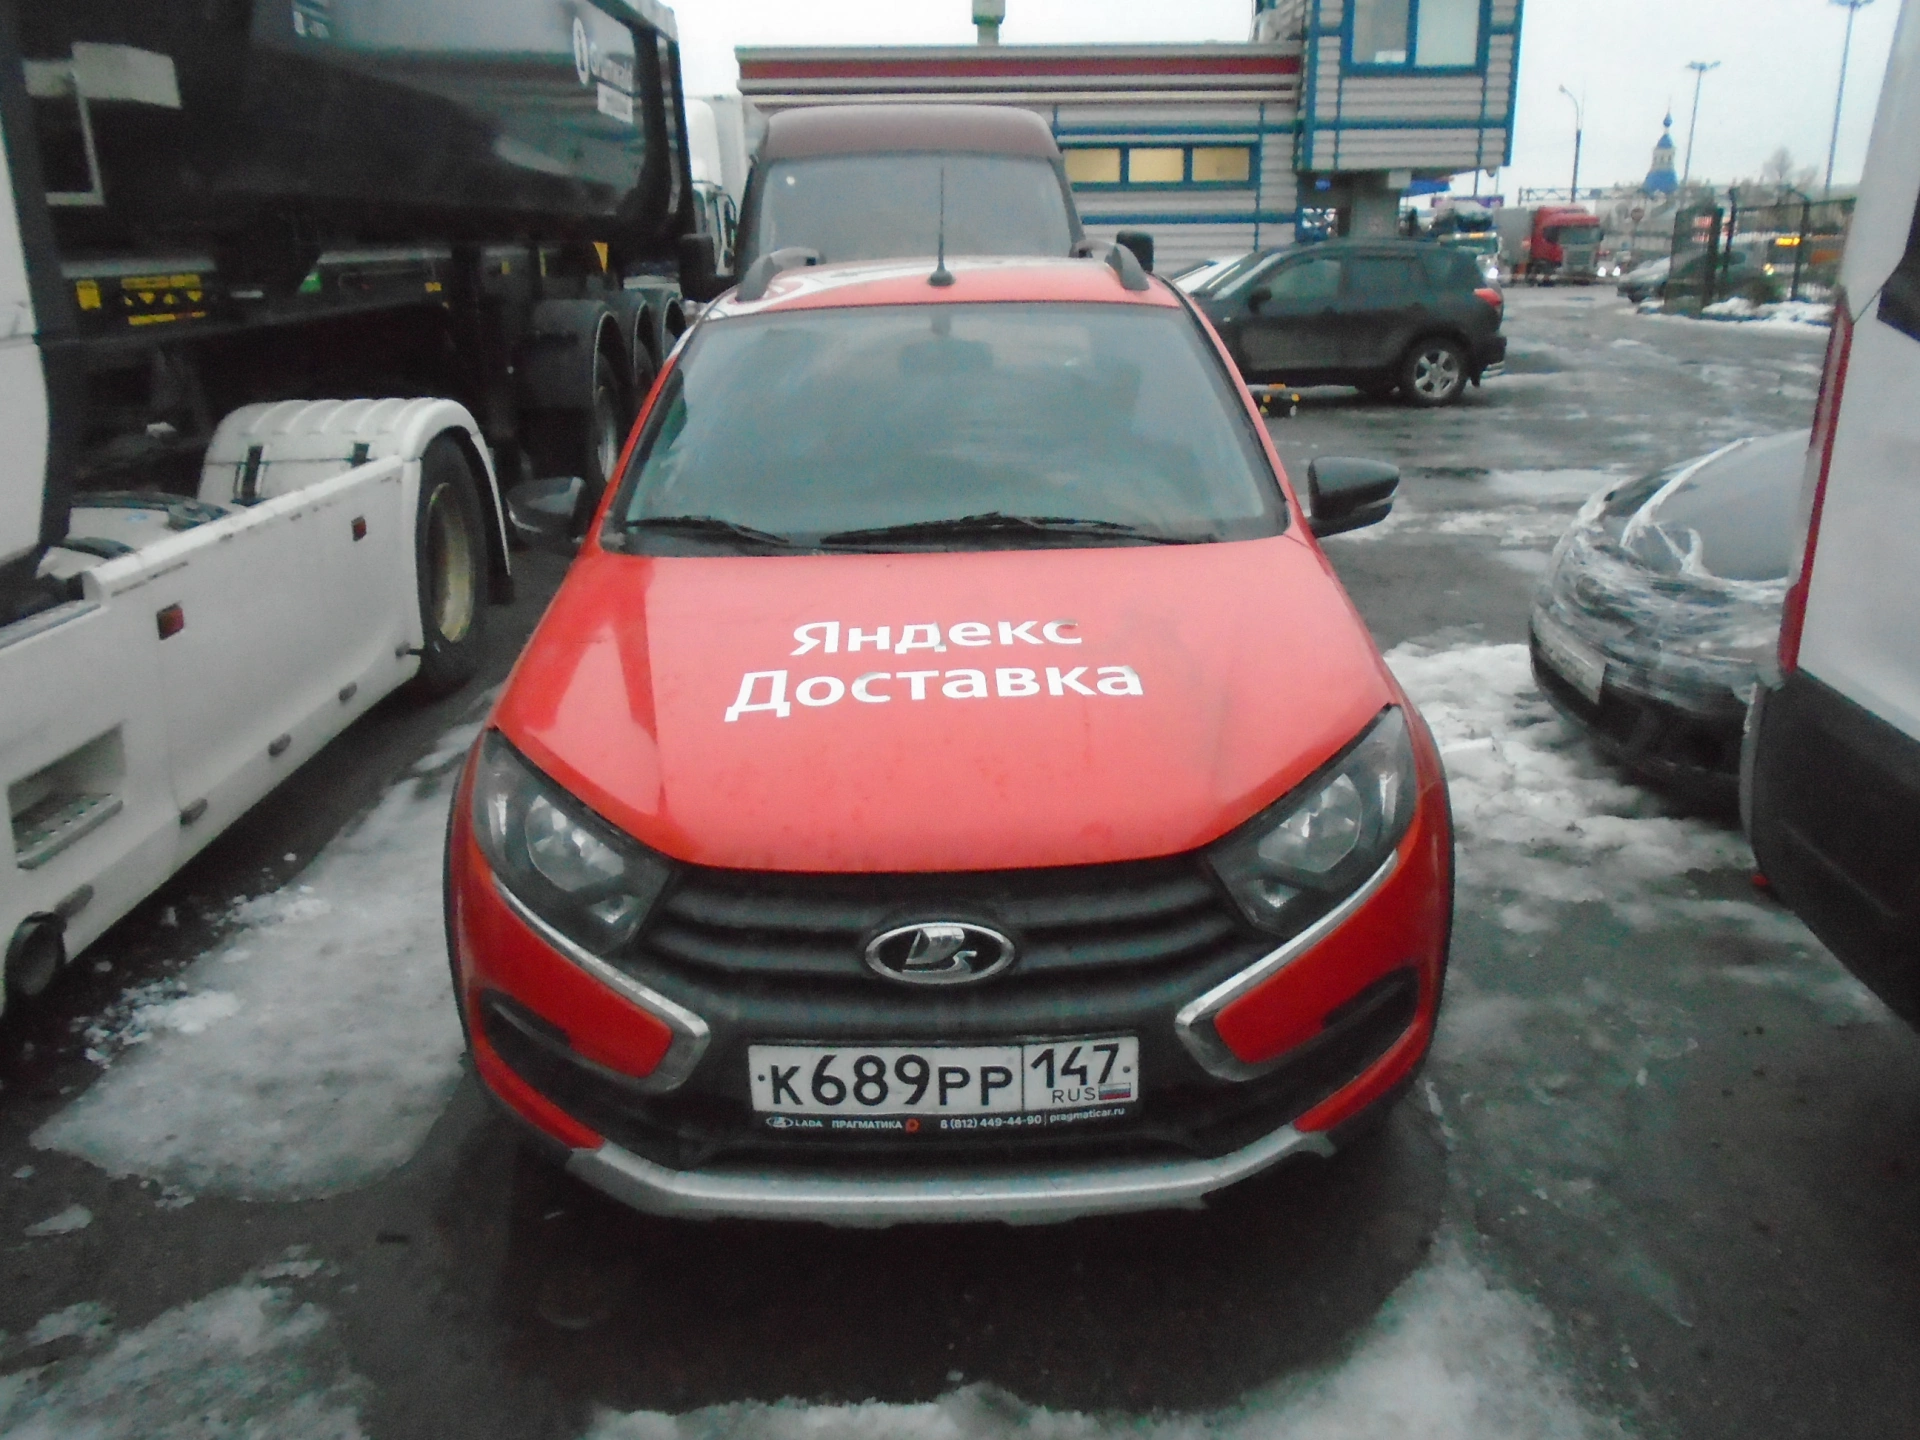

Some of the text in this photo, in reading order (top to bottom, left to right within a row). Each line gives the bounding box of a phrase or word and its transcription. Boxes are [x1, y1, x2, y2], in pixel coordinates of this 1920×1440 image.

[790, 619, 1083, 656] Яндекс
[724, 665, 1145, 723] Доставка
[1030, 1043, 1120, 1088] 147
[1051, 1087, 1096, 1104] RUS
[795, 1119, 823, 1128] LADA
[831, 1119, 903, 1129] ПРАГМАТИКА
[1050, 1108, 1125, 1123] pragmaticar.ru
